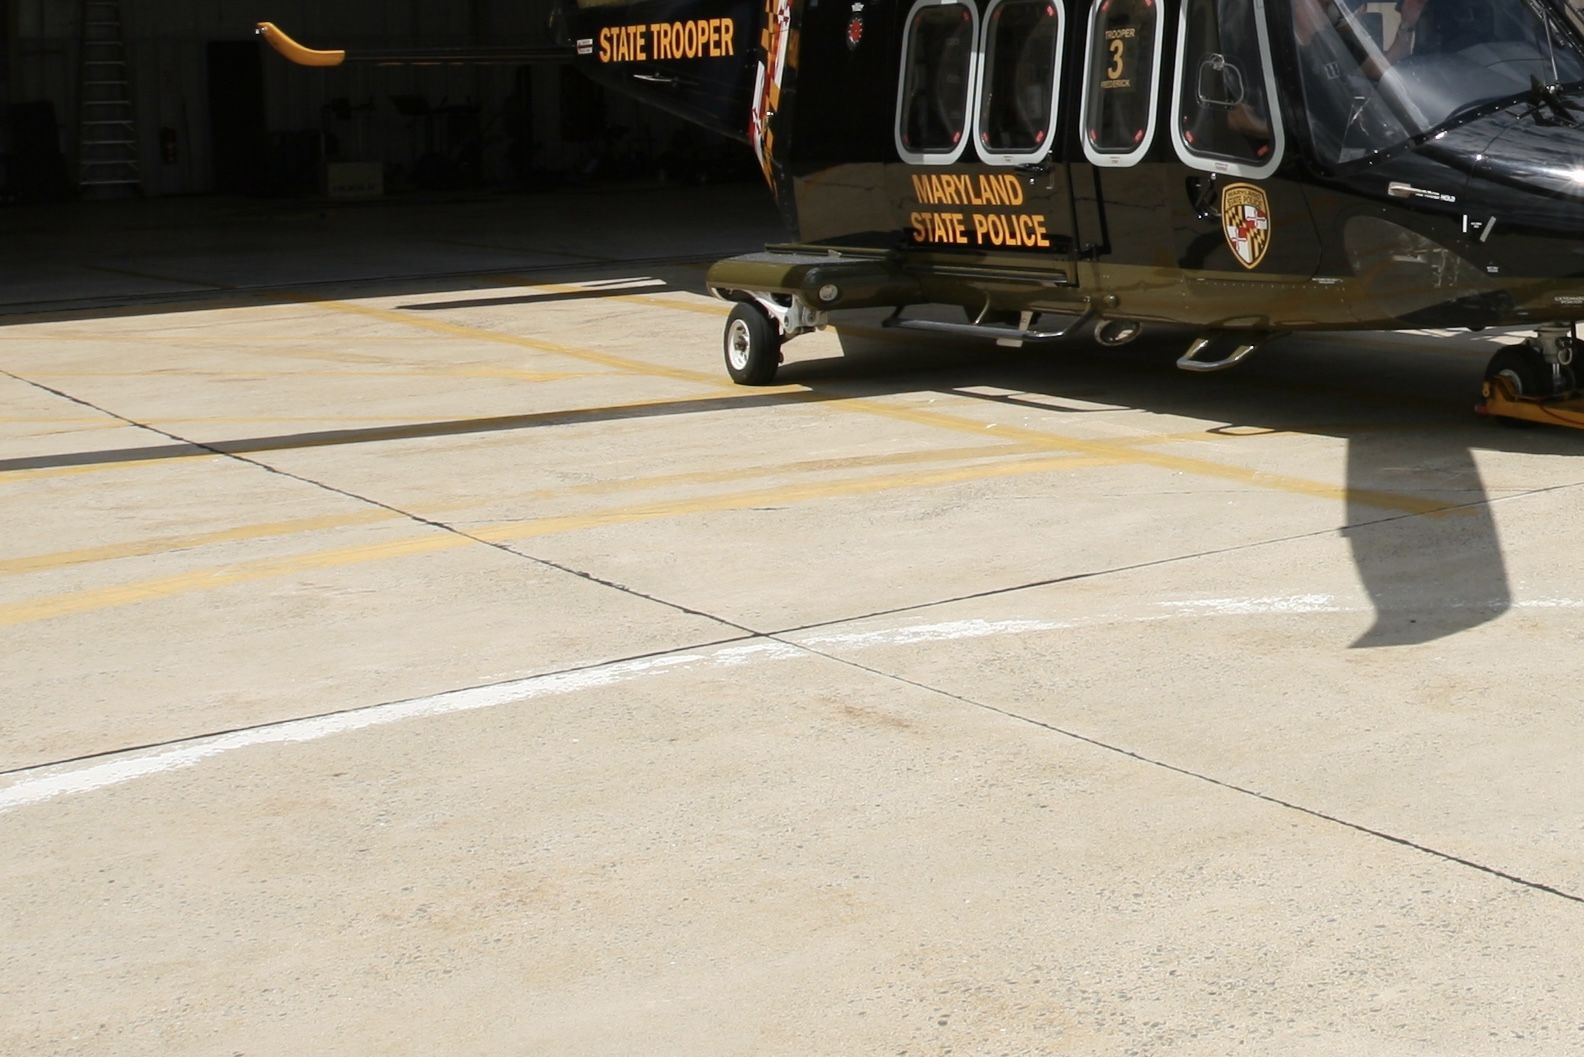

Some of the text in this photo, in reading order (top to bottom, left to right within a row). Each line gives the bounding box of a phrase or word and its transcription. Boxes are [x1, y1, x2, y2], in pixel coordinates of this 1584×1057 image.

[599, 17, 735, 63] STATE TROOPER
[1105, 28, 1135, 40] TROOPER
[1107, 39, 1124, 80] 3
[911, 174, 1024, 206] MARYLAND
[910, 212, 1050, 247] STATE POLICE
